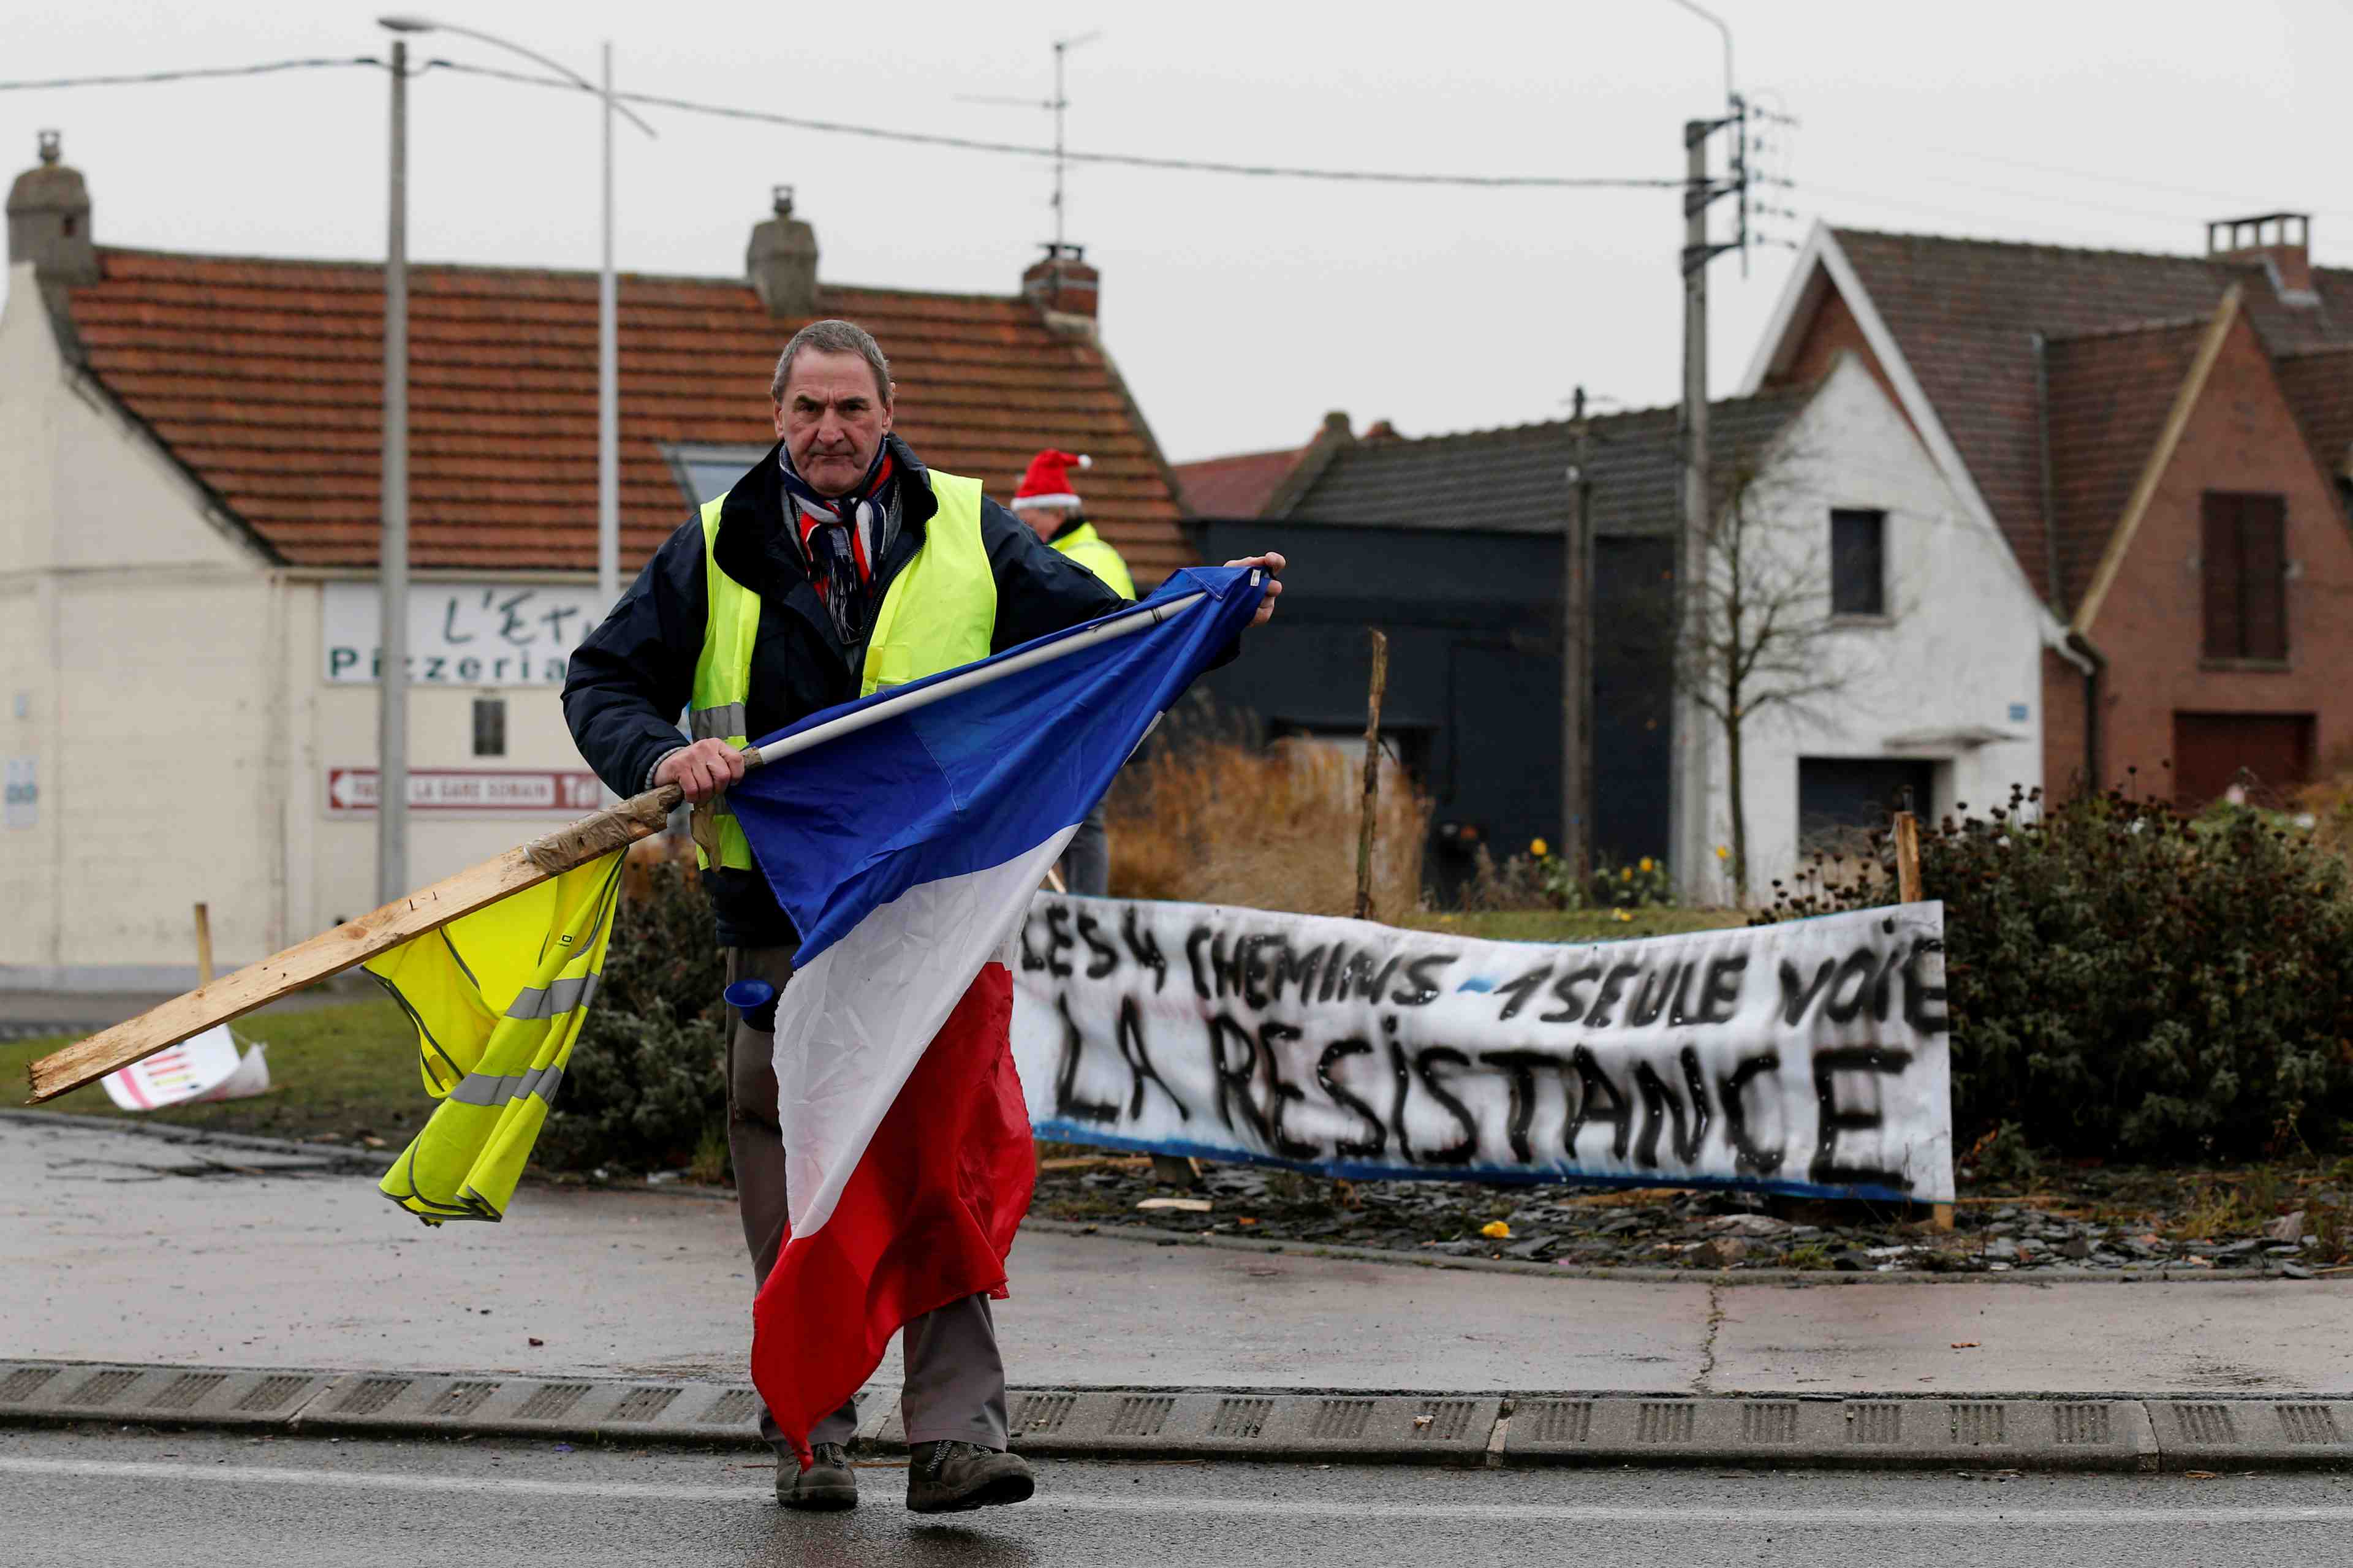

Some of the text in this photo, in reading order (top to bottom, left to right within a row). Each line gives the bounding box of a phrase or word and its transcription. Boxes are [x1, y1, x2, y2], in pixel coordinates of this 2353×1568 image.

[1021, 903, 1120, 979] LES
[1121, 903, 1169, 995] 4
[1185, 923, 1461, 1010] CHEMINS
[1538, 953, 1750, 1028] SEULE
[1056, 991, 1191, 1123] LA
